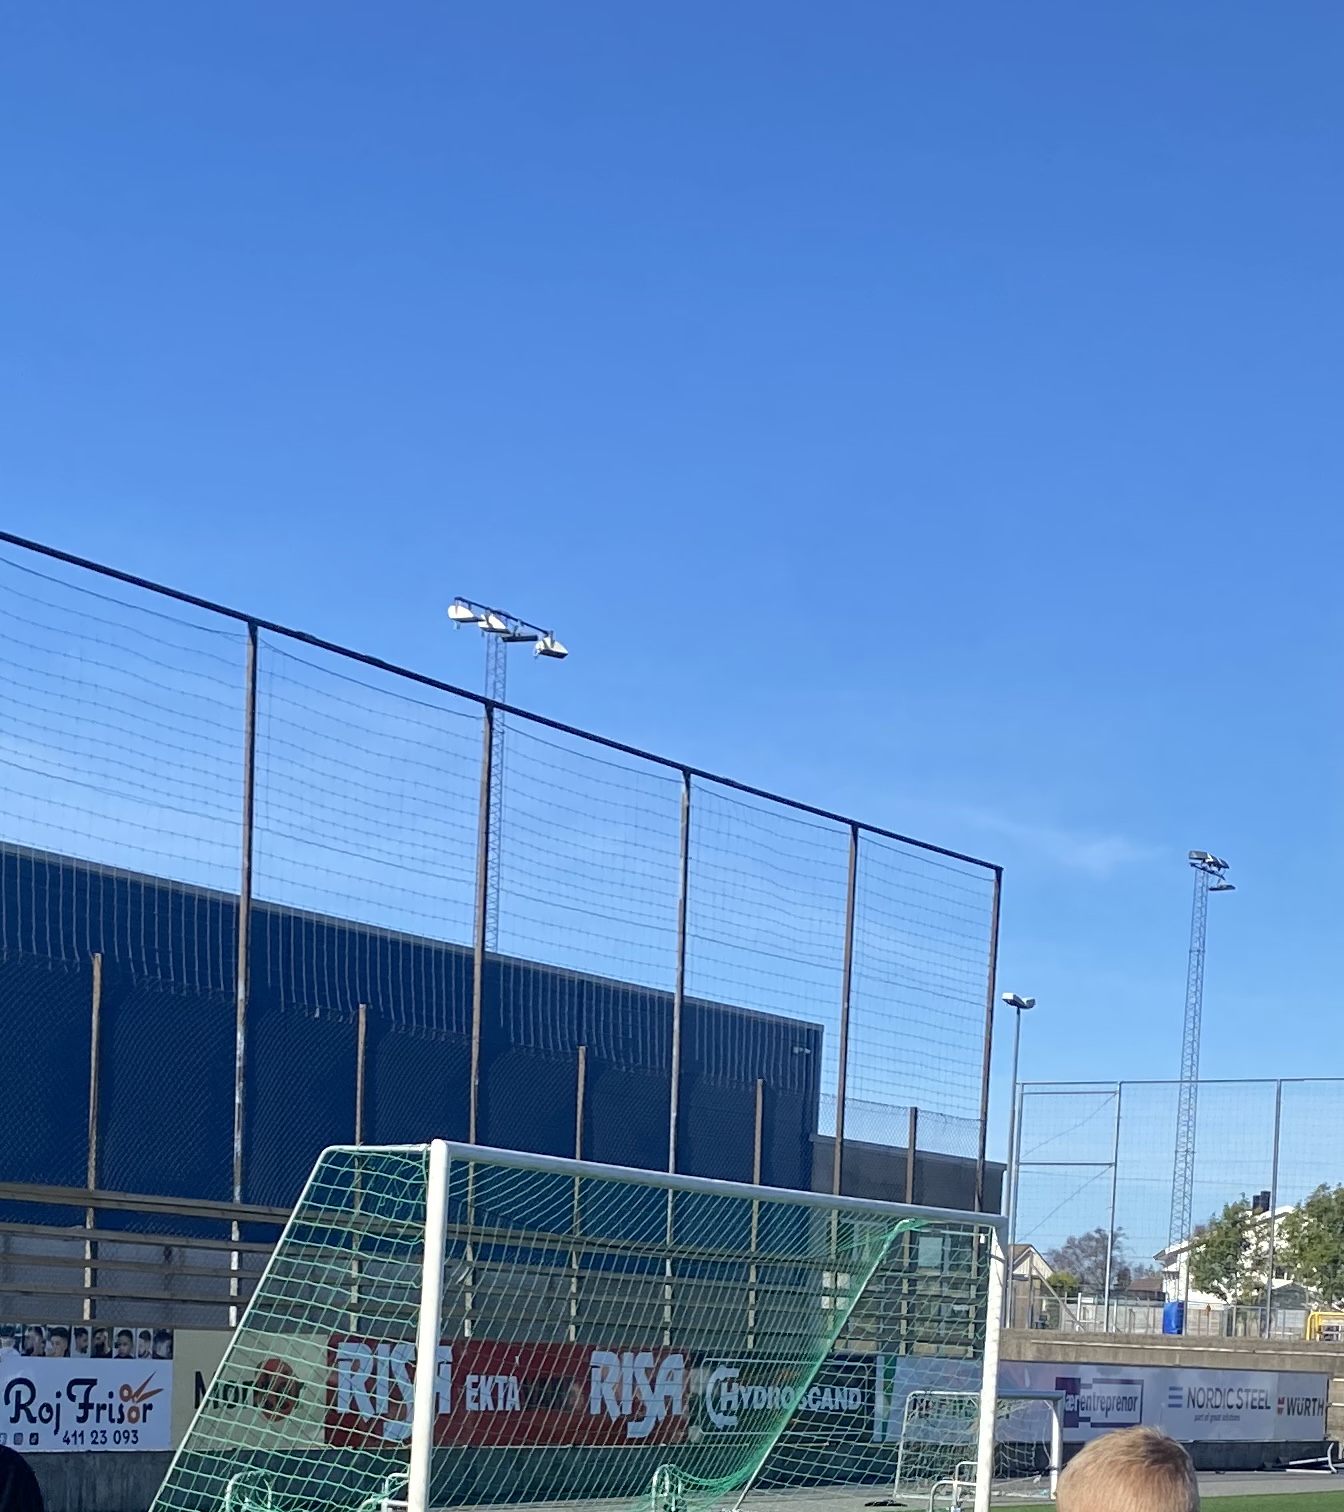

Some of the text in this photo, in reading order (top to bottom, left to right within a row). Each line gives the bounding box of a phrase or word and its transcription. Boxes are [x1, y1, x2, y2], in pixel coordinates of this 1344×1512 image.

[4, 1377, 61, 1436] Roj
[589, 1351, 686, 1438] RISA
[1187, 1387, 1271, 1410] NORDIC STEEL
[63, 1429, 139, 1445] 411 23 093
